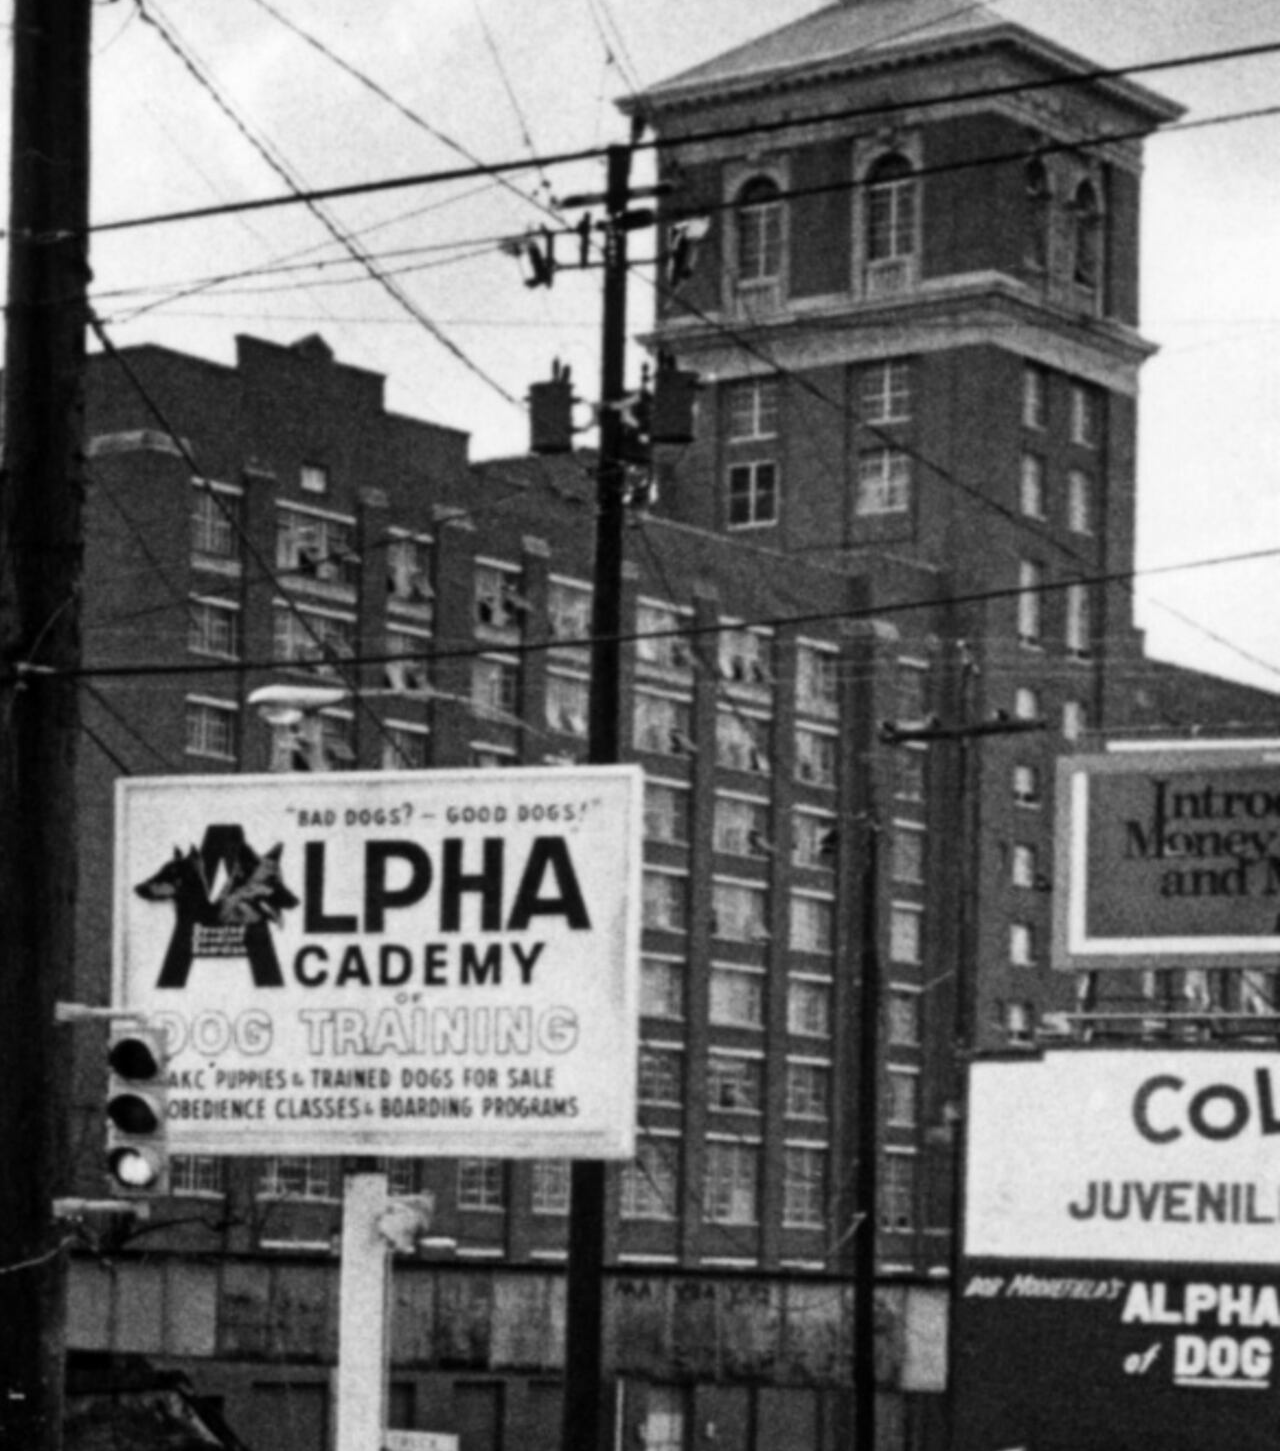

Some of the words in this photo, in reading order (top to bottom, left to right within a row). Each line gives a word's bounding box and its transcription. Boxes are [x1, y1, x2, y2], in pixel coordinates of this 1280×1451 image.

[344, 802, 414, 827] DOGS?
[446, 804, 507, 825] GOOD
[1123, 818, 1278, 860] Money
[1160, 858, 1252, 898] and
[154, 1008, 273, 1057] DOG
[298, 1005, 581, 1057] TRAINING
[168, 1069, 205, 1090] AKC
[216, 1068, 287, 1089] PUPPIES
[311, 1067, 392, 1089] TRAINED
[401, 1067, 454, 1090] DOGS
[463, 1067, 498, 1089] FOR
[508, 1067, 555, 1089] SALE
[167, 1097, 265, 1120] OBEDIENCE
[275, 1097, 360, 1119] CLASSES
[380, 1097, 472, 1119] BOARDING
[482, 1096, 579, 1119] PROGRAMS
[1068, 1181, 1280, 1224] JUVENIL
[1122, 1281, 1280, 1328] ALPHA
[1124, 1343, 1162, 1374] of
[1173, 1334, 1272, 1378] DOG
